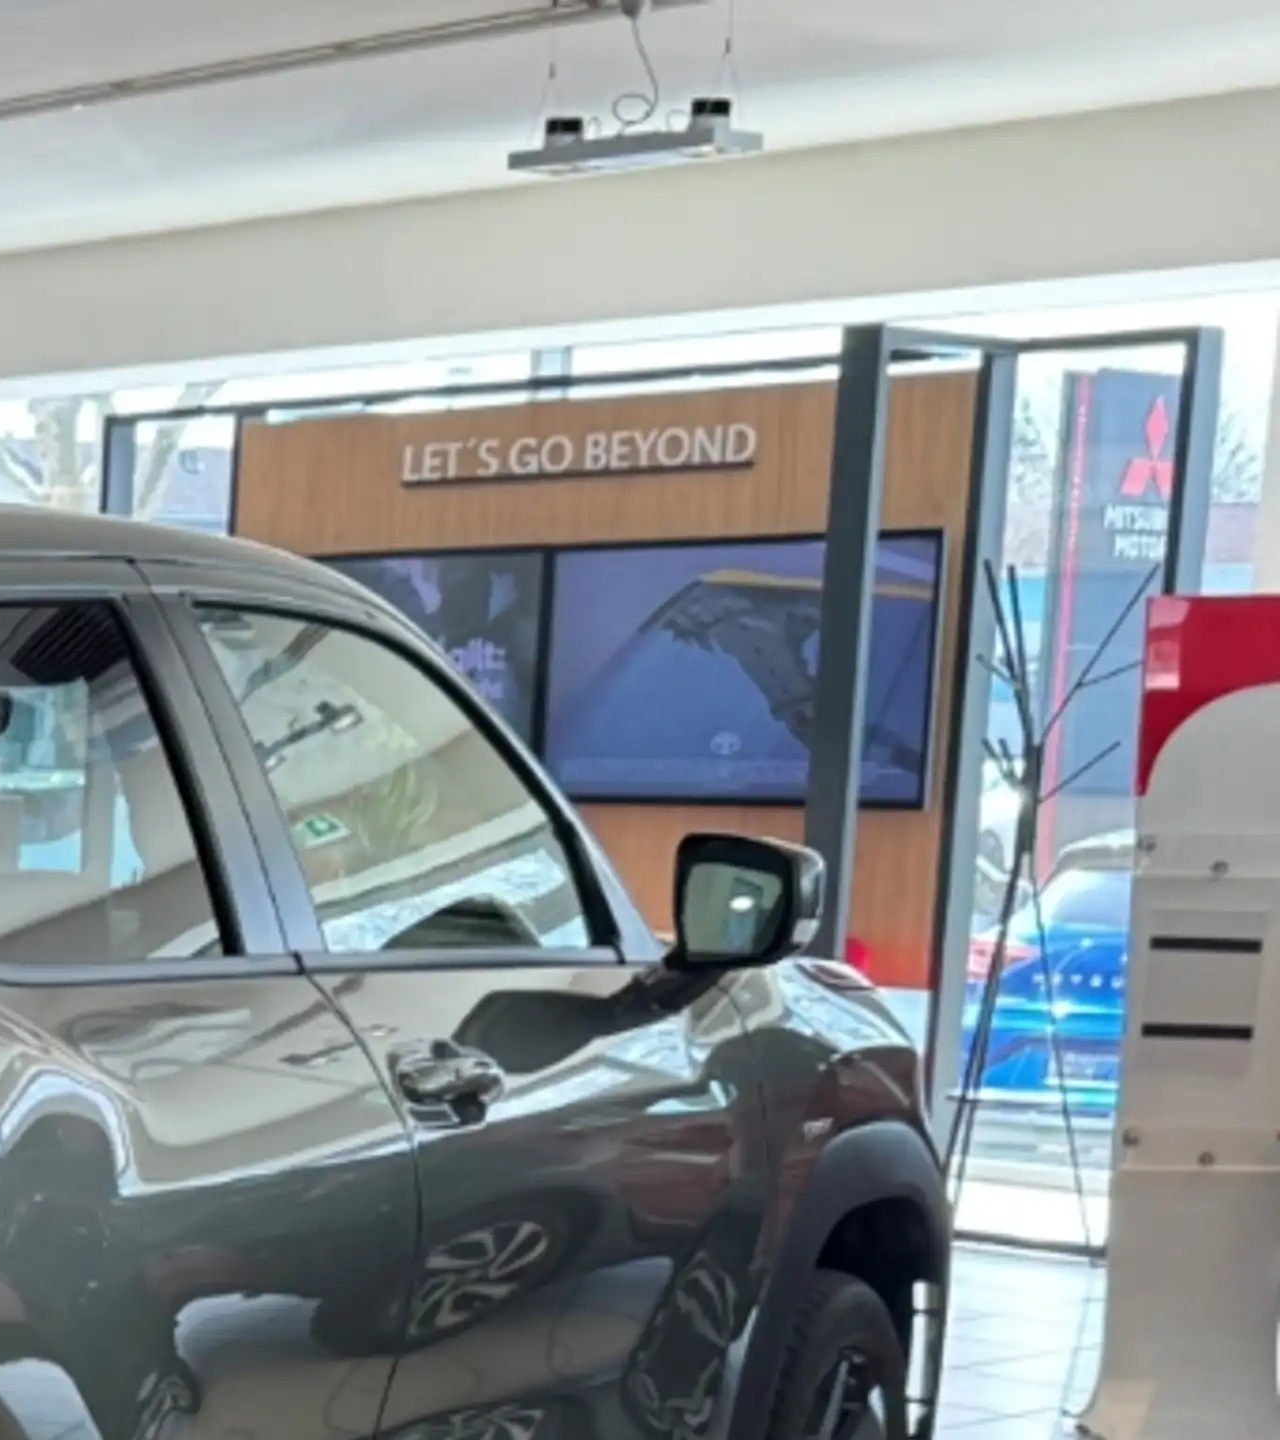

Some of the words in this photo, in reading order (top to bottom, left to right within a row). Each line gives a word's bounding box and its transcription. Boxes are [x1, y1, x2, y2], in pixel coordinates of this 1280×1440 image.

[401, 437, 501, 483] LET'S
[508, 435, 573, 475] GO
[584, 422, 757, 472] BEYOND
